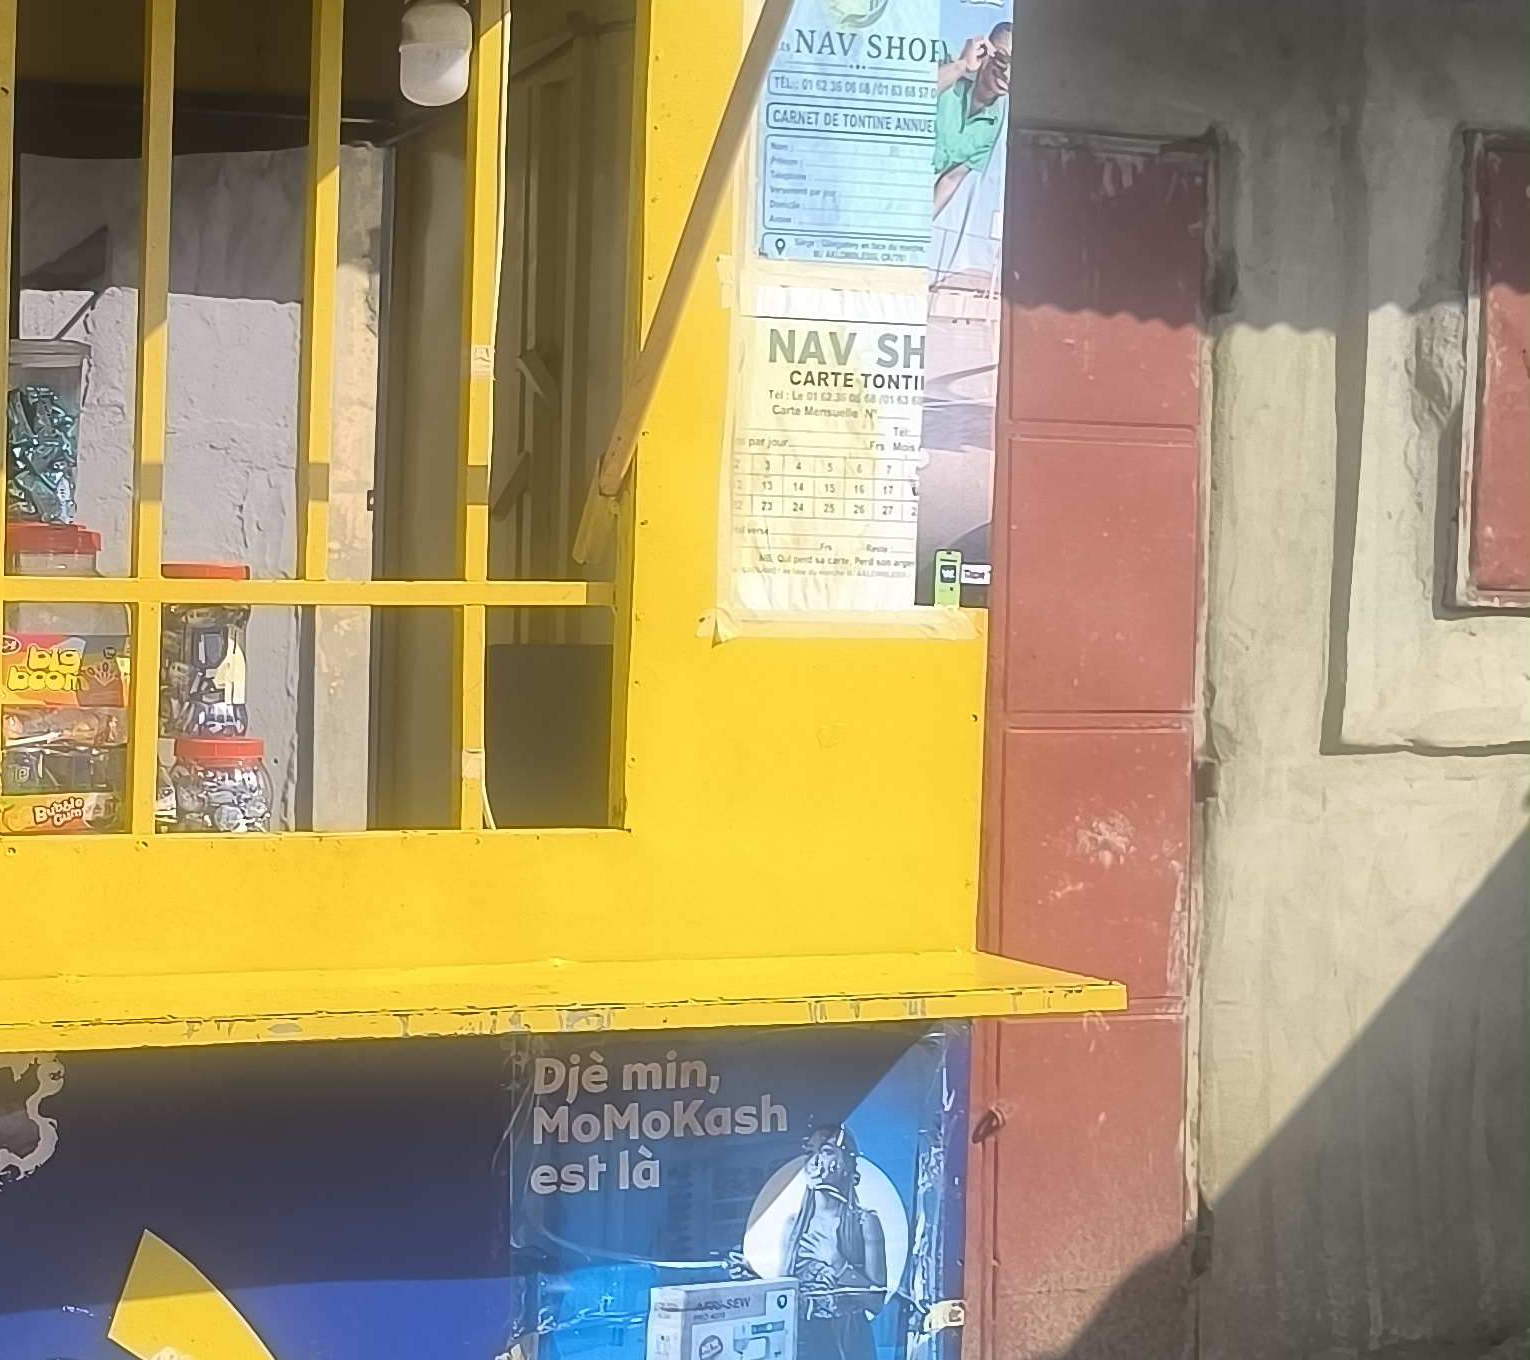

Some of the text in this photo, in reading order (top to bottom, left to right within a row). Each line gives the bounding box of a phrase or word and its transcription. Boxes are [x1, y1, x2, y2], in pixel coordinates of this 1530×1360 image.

[795, 29, 859, 56] NAV
[773, 109, 820, 125] CARNET
[824, 112, 839, 126] DE
[843, 113, 892, 130] TONTINE
[769, 329, 857, 365] NAV
[790, 370, 924, 390] CARTE TONTI
[772, 404, 801, 416] Carte
[796, 461, 801, 470] 4
[827, 463, 833, 473] 5
[793, 482, 803, 491] 14
[825, 483, 835, 493] 15
[883, 485, 893, 495] 17
[792, 502, 803, 512] 24
[824, 503, 835, 513] 25
[854, 504, 865, 514] 26
[882, 505, 893, 515] 27
[27, 644, 82, 675] big
[7, 665, 89, 691] boom
[34, 797, 84, 824] Bubble
[52, 808, 83, 828] Gum
[533, 1050, 720, 1104] Djè min,
[533, 1094, 788, 1145] MoMoKash
[530, 1145, 660, 1195] est là
